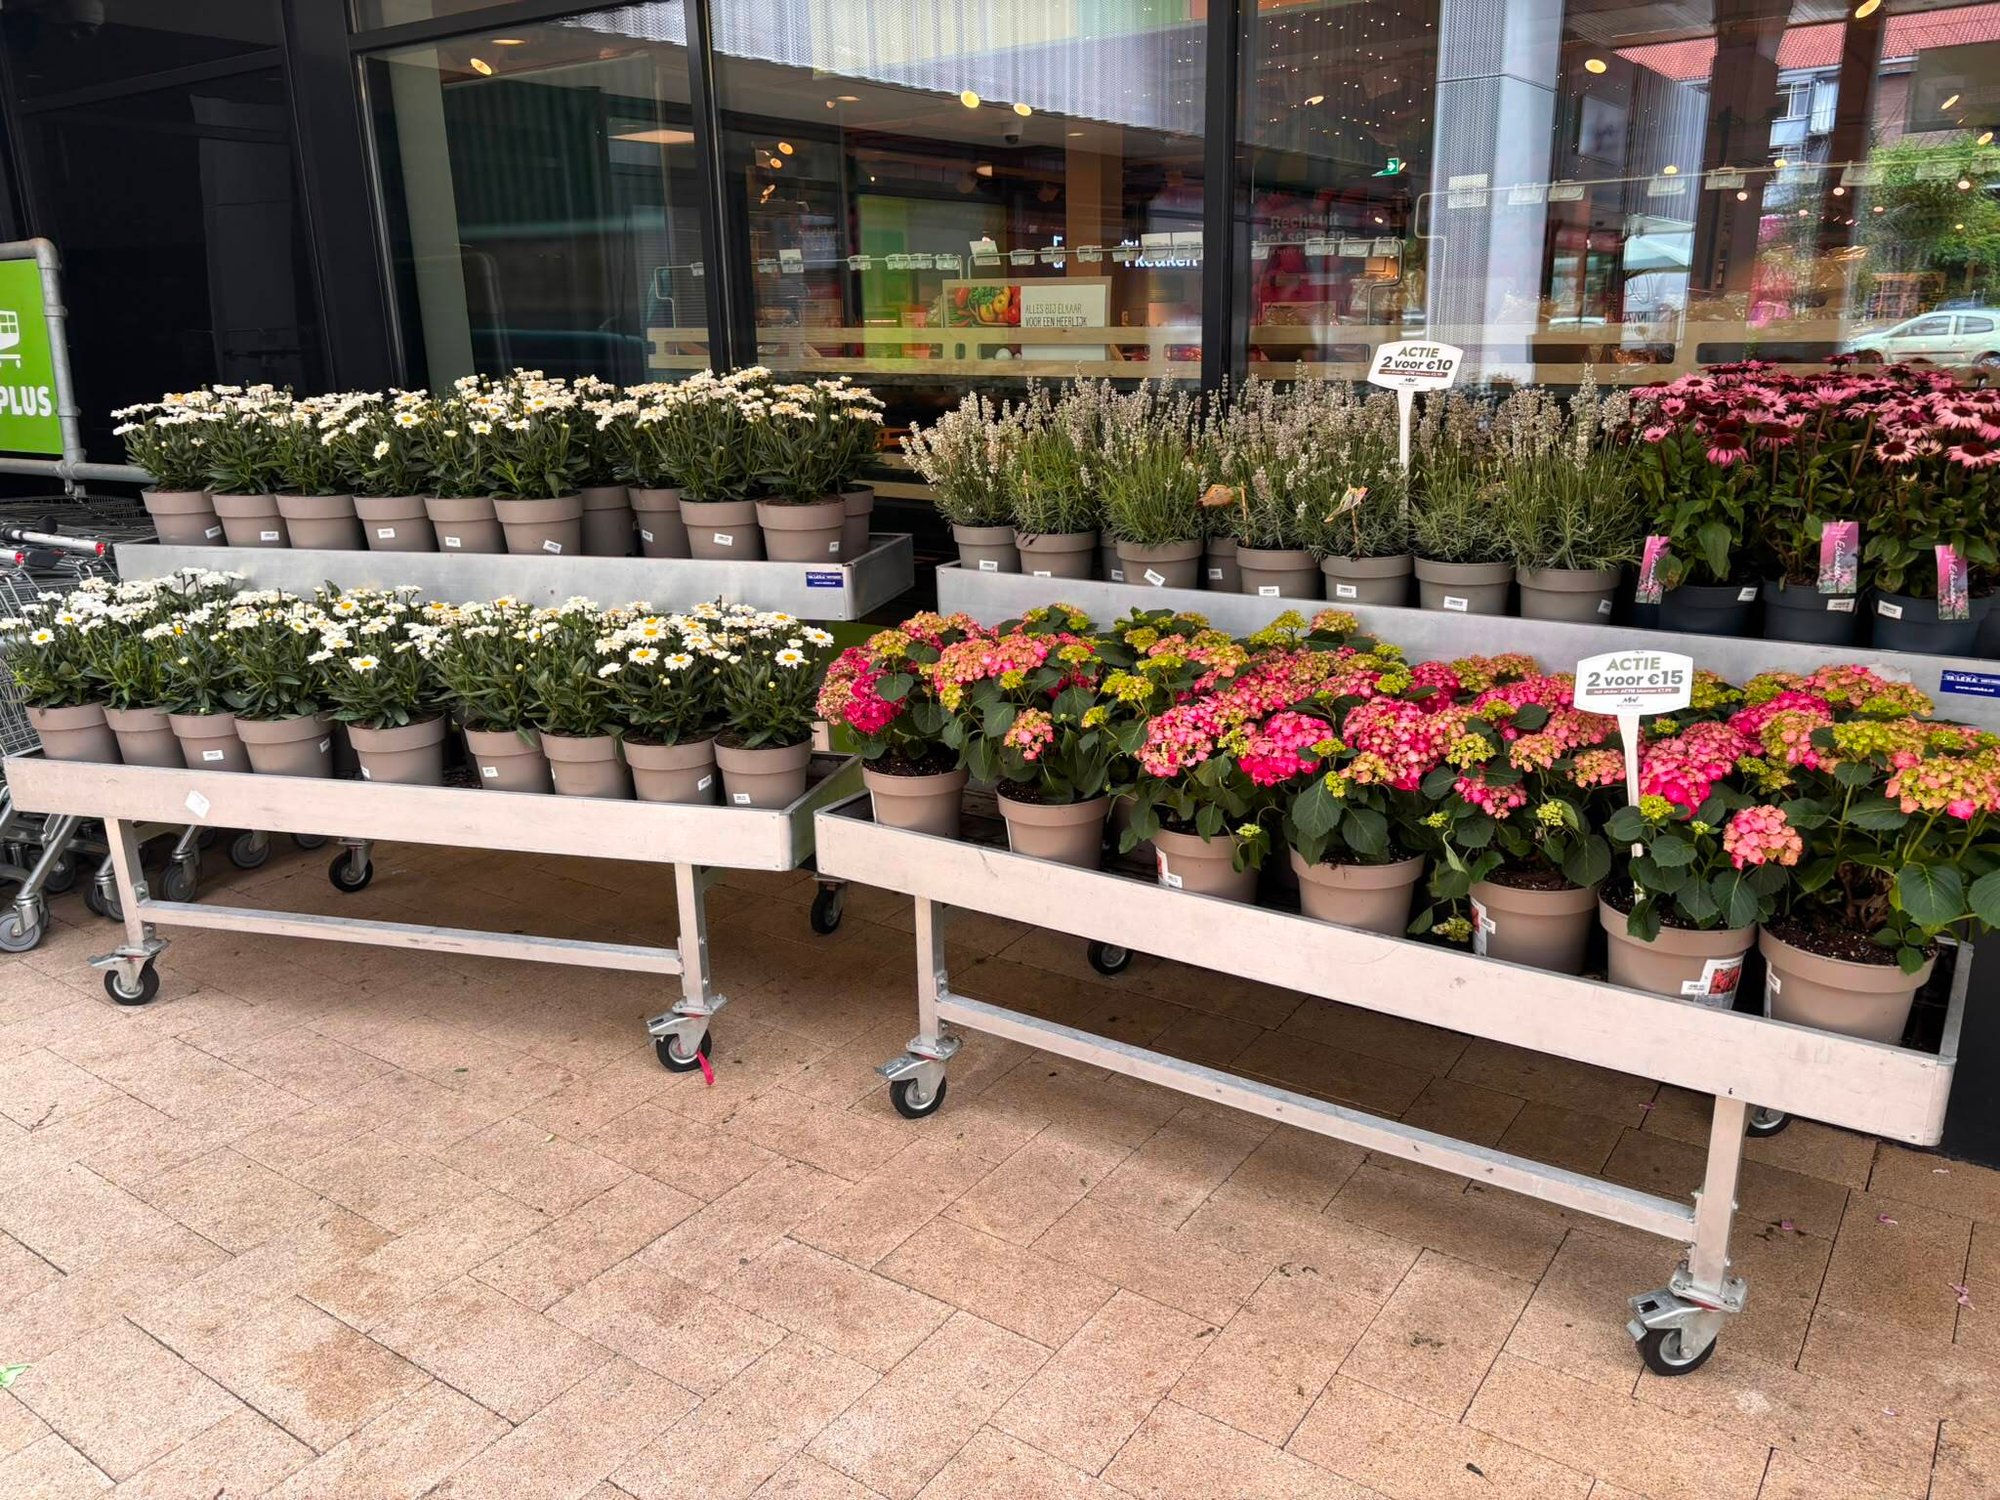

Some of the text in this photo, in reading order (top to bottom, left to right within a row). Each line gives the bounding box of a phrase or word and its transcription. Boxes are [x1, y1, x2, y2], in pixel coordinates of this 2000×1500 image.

[1025, 303, 1082, 315] ALLES BIJ ELKAAR
[1025, 315, 1088, 327] VOOR EEN HEERLIJK
[1398, 346, 1440, 359] ACTIE
[1381, 356, 1453, 371] 2 voor €10
[0, 386, 52, 416] PLUS
[1606, 656, 1661, 671] ACTIE
[1587, 669, 1684, 687] 2 voor €15
